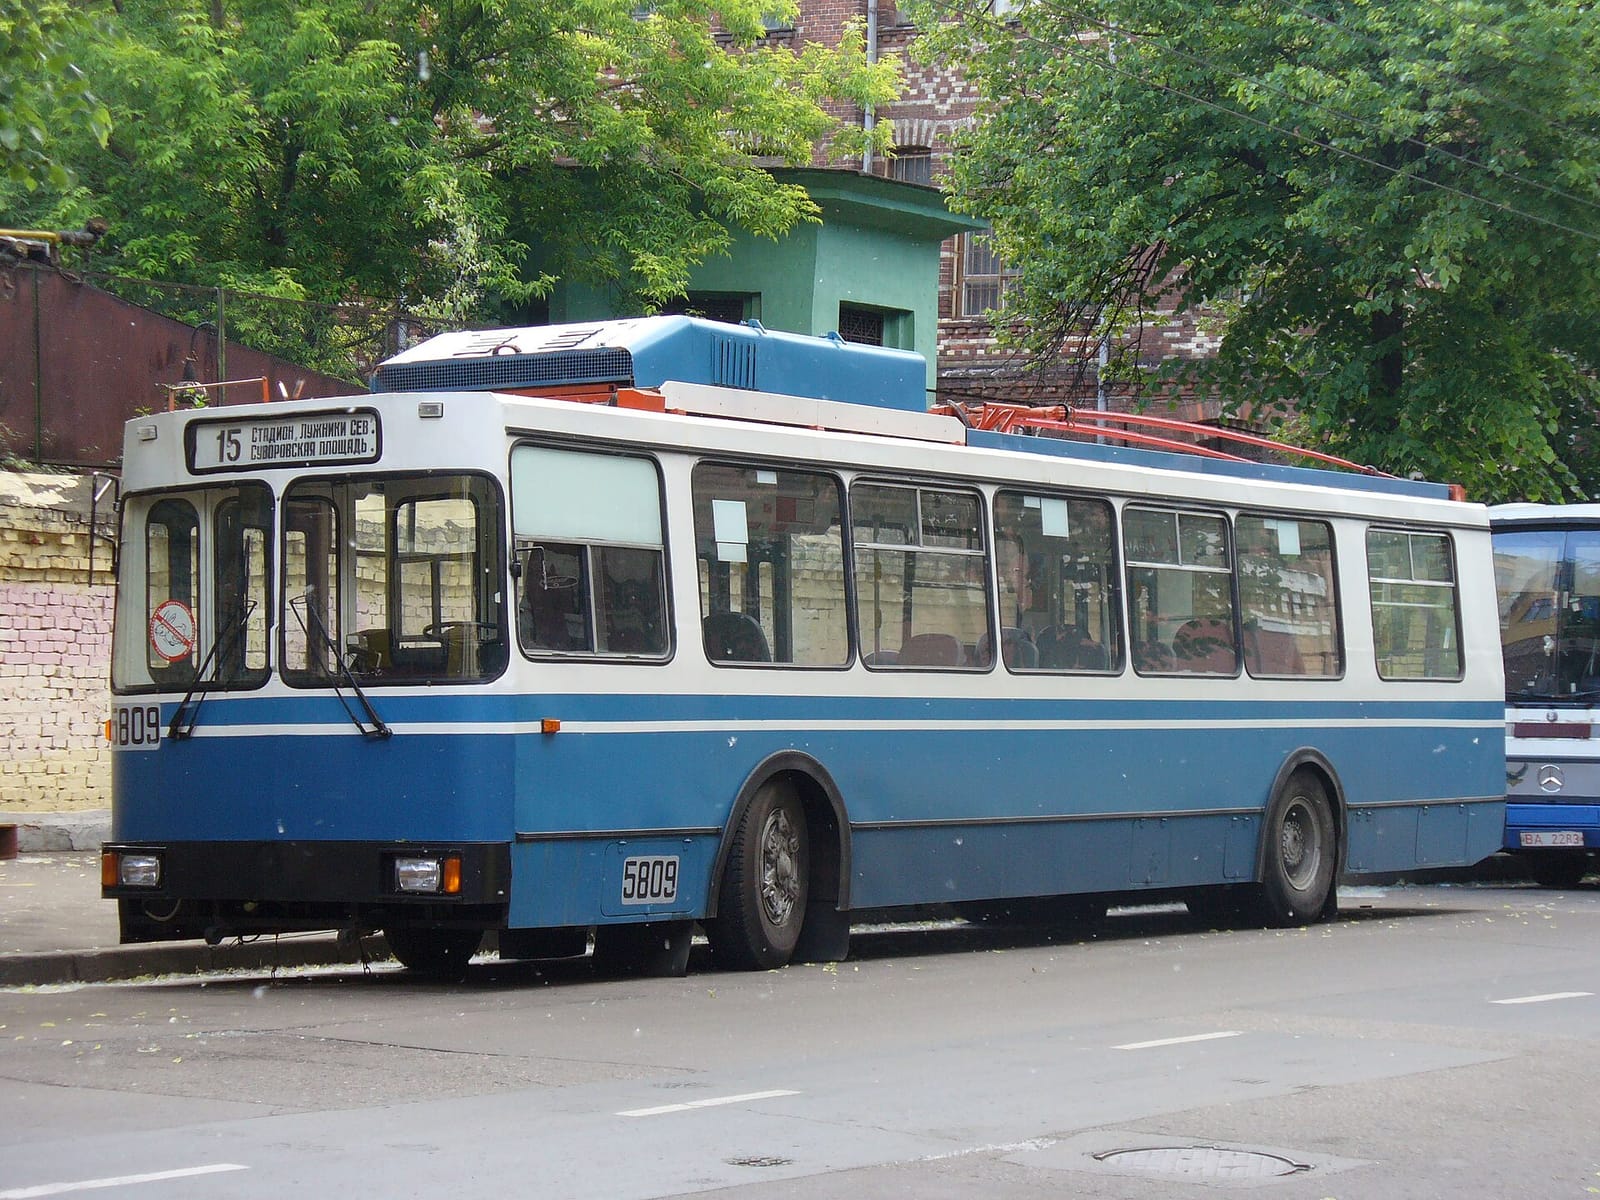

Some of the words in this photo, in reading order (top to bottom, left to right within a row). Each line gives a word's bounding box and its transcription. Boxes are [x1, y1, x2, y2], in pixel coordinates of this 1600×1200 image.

[216, 428, 241, 463] 15
[250, 441, 315, 460] СУВОРОВСКАЯ
[623, 860, 677, 899] 5809
